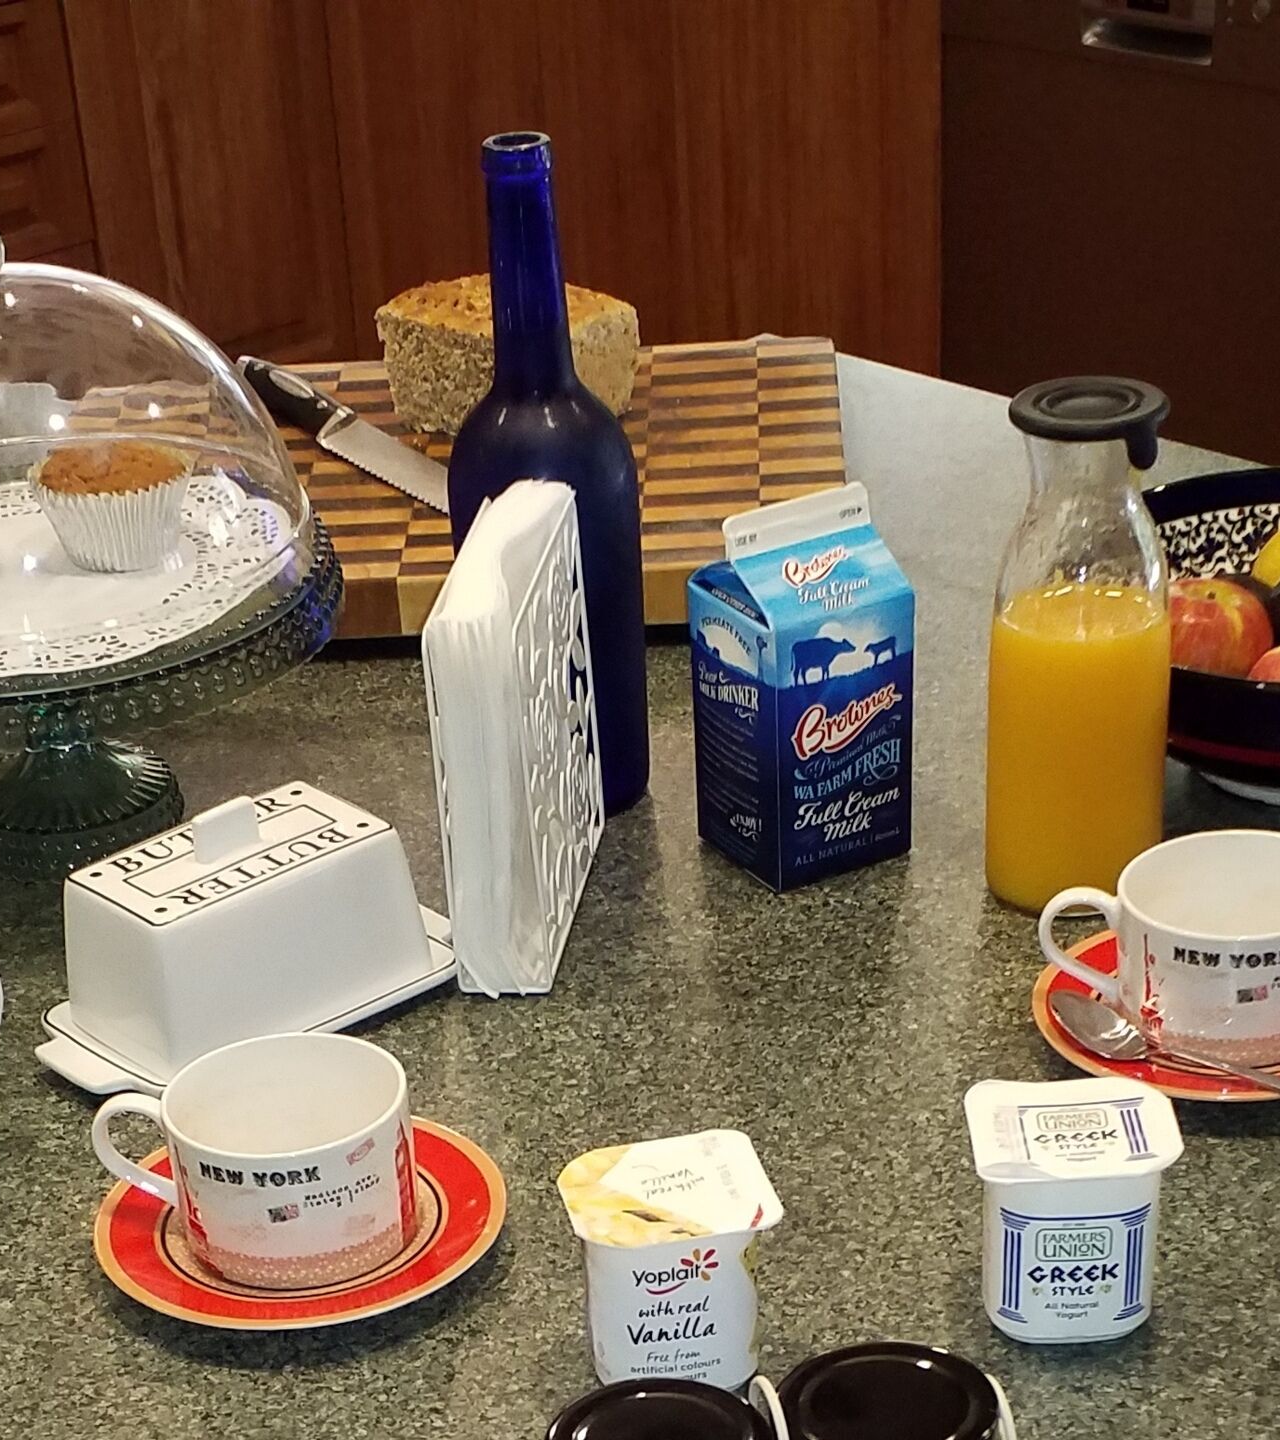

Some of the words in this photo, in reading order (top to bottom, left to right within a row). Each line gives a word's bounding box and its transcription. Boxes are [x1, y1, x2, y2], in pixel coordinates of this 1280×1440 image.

[798, 586, 826, 604] Full
[829, 577, 870, 597] Cream
[717, 684, 759, 711] DRINKER
[792, 684, 901, 760] Brownes
[794, 785, 814, 800] WA
[817, 765, 852, 797] FARM
[855, 738, 901, 780] FRESH
[794, 801, 843, 831] Full
[844, 786, 901, 817] Cream
[108, 797, 292, 874] BUTR
[823, 811, 873, 842] Milk
[795, 853, 814, 867] ALL
[819, 838, 866, 860] NATURAL
[167, 828, 354, 905] BUTTER
[1173, 946, 1221, 968] NEW
[1044, 1118, 1101, 1130] UNION
[1034, 1130, 1119, 1144] GREEK
[199, 1161, 244, 1186] NEW
[252, 1166, 321, 1188] YORK
[1042, 1231, 1107, 1244] FARMERS
[1042, 1243, 1105, 1258] UNION
[1027, 1263, 1120, 1284] GREEK
[1051, 1285, 1094, 1297] STYLE
[638, 1301, 675, 1319] with
[678, 1295, 710, 1315] real
[1055, 1310, 1088, 1320] Yogurt
[1061, 1301, 1099, 1310] Natural
[627, 1315, 717, 1346] Vanilla
[630, 1364, 678, 1376] artificial
[680, 1357, 722, 1372] colours
[646, 1351, 670, 1364] Free
[674, 1348, 701, 1363] from
